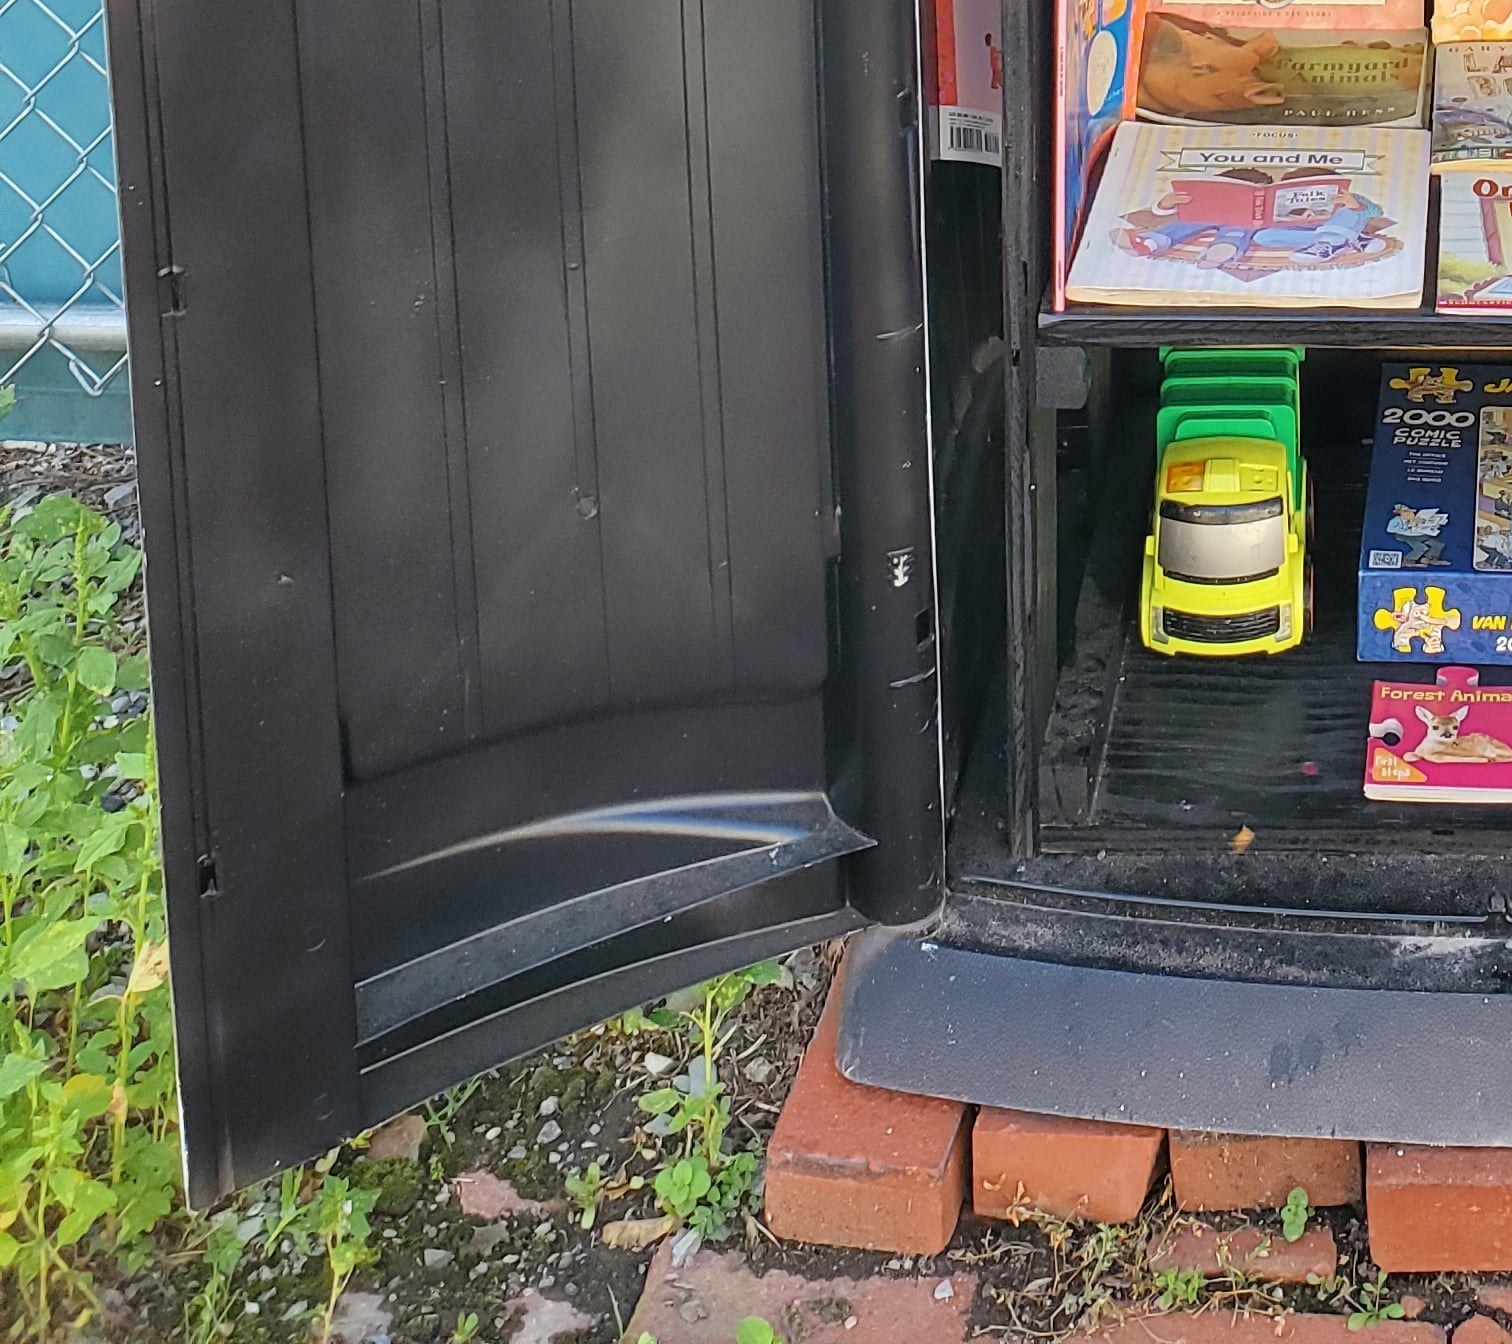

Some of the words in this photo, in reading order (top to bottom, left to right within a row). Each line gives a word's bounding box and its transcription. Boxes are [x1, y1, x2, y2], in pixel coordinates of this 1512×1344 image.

[1276, 57, 1409, 73] Farmyard
[1290, 69, 1400, 84] Animals
[1284, 108, 1334, 117] PAUL
[1200, 152, 1245, 163] You
[1253, 153, 1303, 164] and
[1307, 154, 1343, 164] Me
[1382, 407, 1476, 428] 2000
[1394, 427, 1461, 440] COMIC
[1392, 436, 1462, 448] PUZZLE
[1471, 615, 1506, 630] VAN
[1381, 686, 1445, 702] Forest
